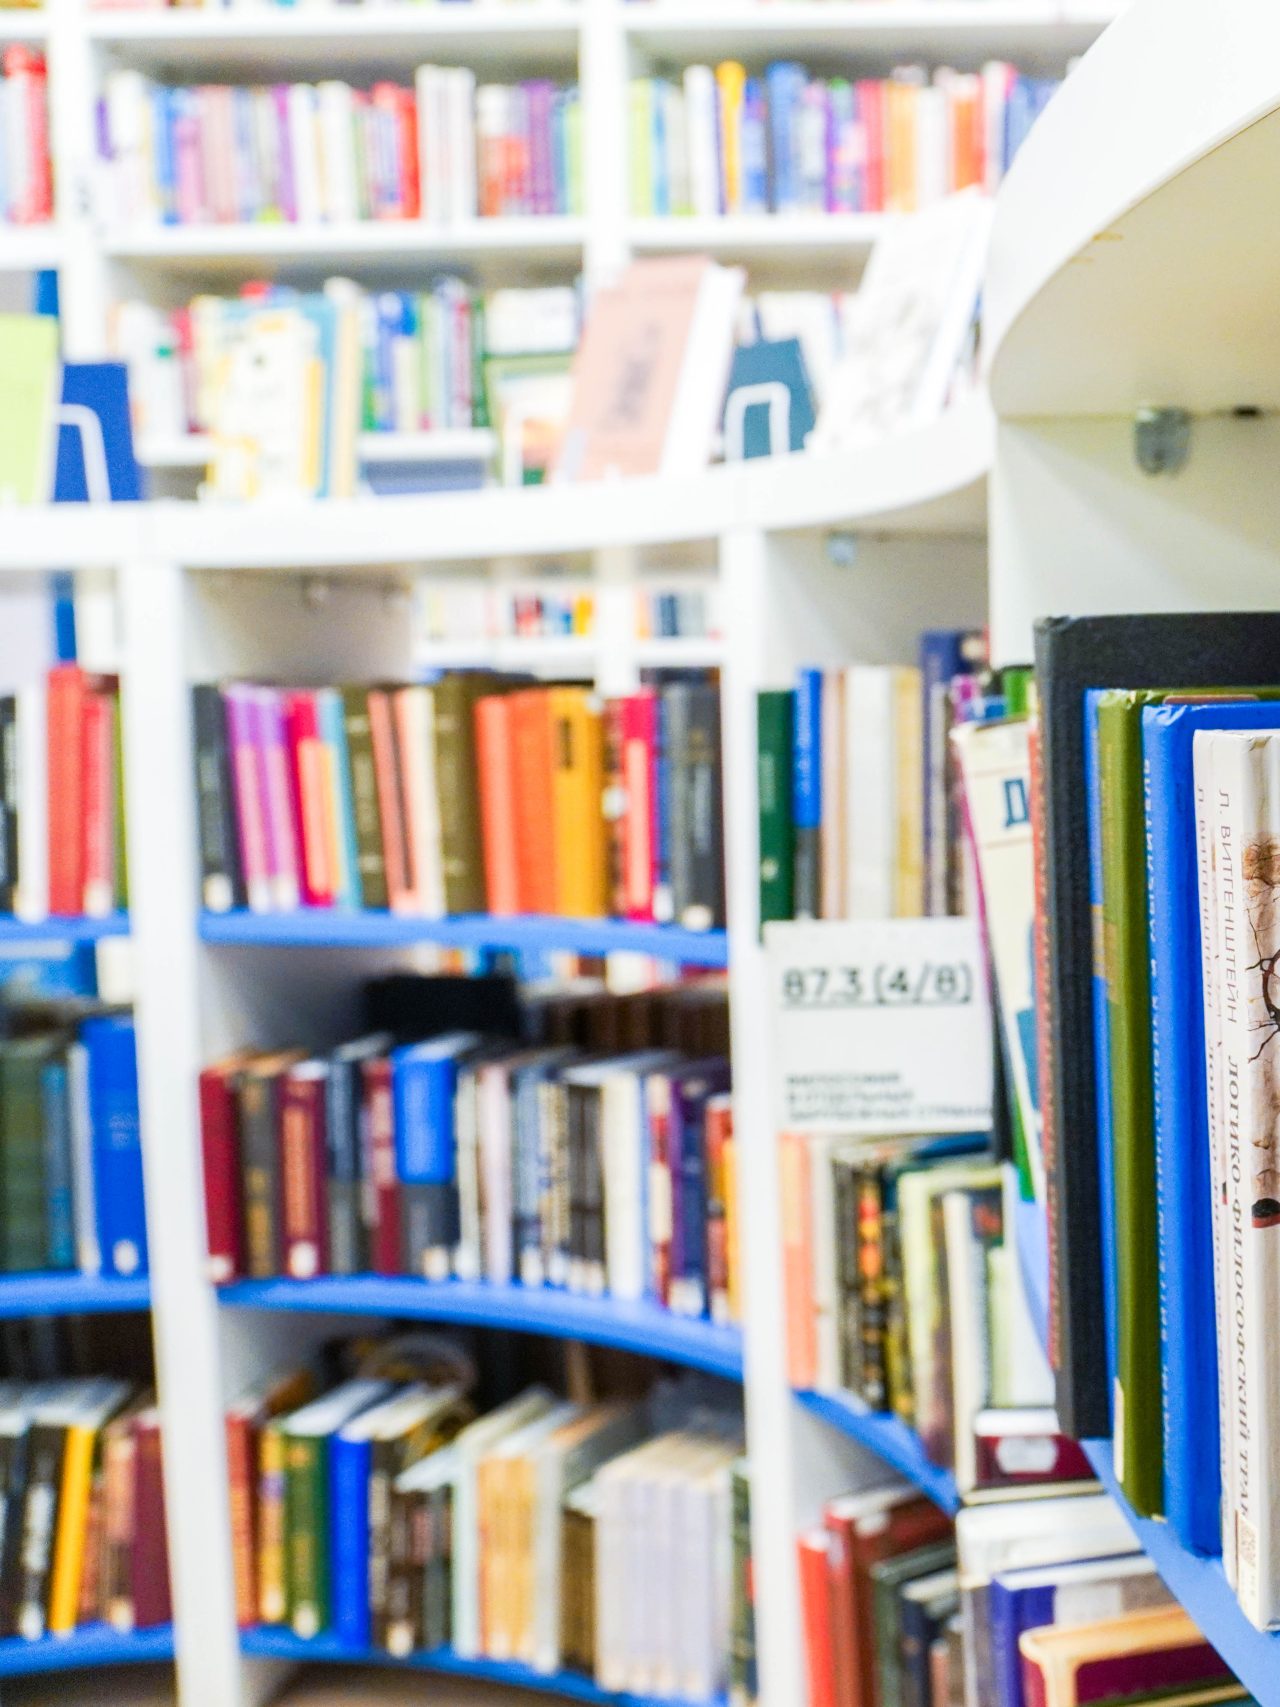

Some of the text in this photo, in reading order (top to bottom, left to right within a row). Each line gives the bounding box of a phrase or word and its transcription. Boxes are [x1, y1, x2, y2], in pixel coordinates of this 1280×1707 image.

[1218, 788, 1231, 815] Л.
[1220, 824, 1240, 1024] ВИТГЕНШТЕЙН
[1228, 1055, 1251, 1441] ЛОГИКО-ФИЛОСОФСКИЙ
